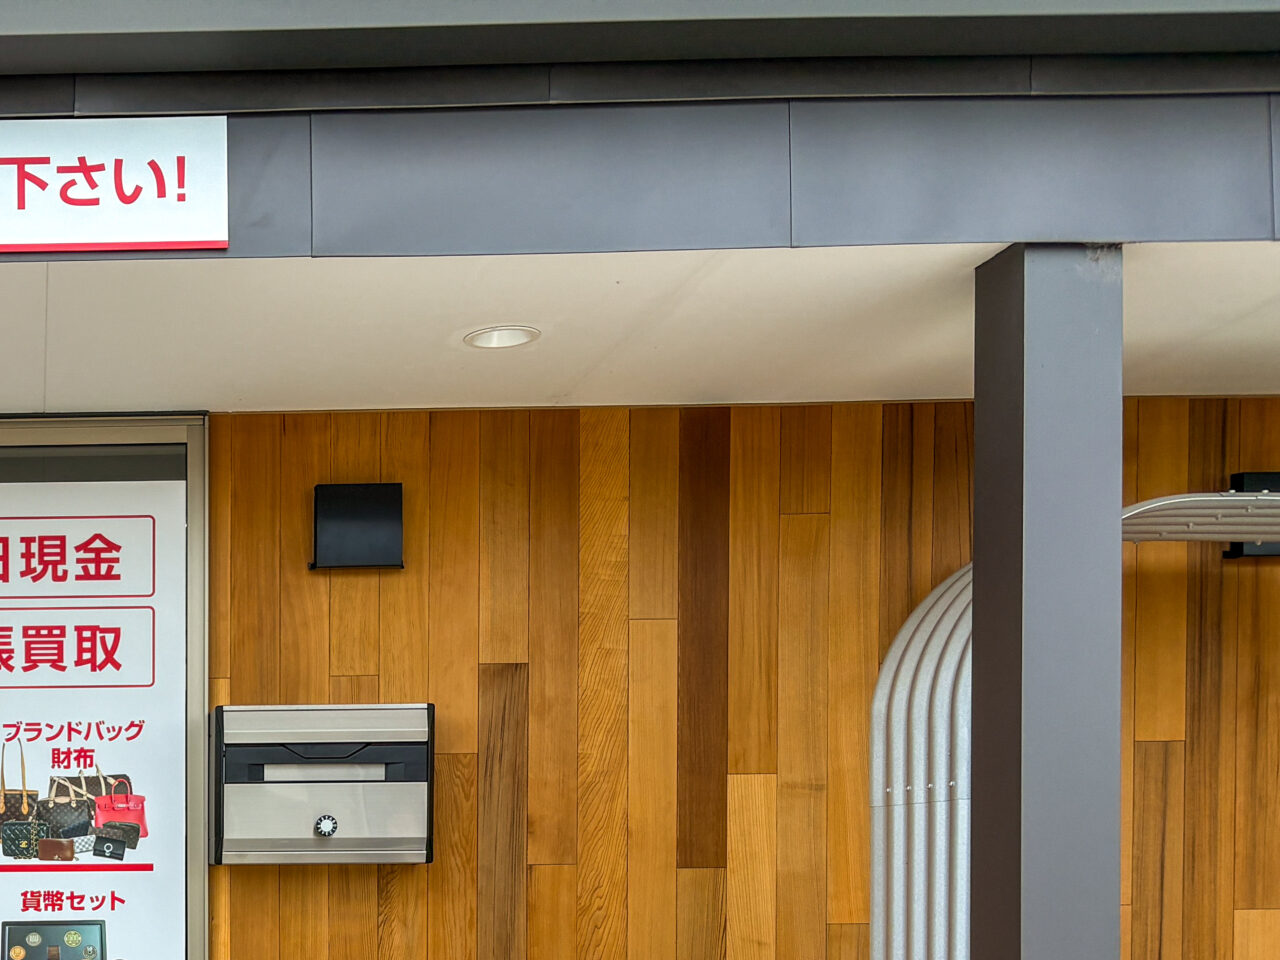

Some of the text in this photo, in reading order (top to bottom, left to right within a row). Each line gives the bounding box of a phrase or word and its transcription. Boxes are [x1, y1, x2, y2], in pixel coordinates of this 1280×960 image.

[2, 720, 145, 743] ブランドバッグ
[51, 748, 95, 769] 財布
[21, 890, 126, 913] 貨幣セット
